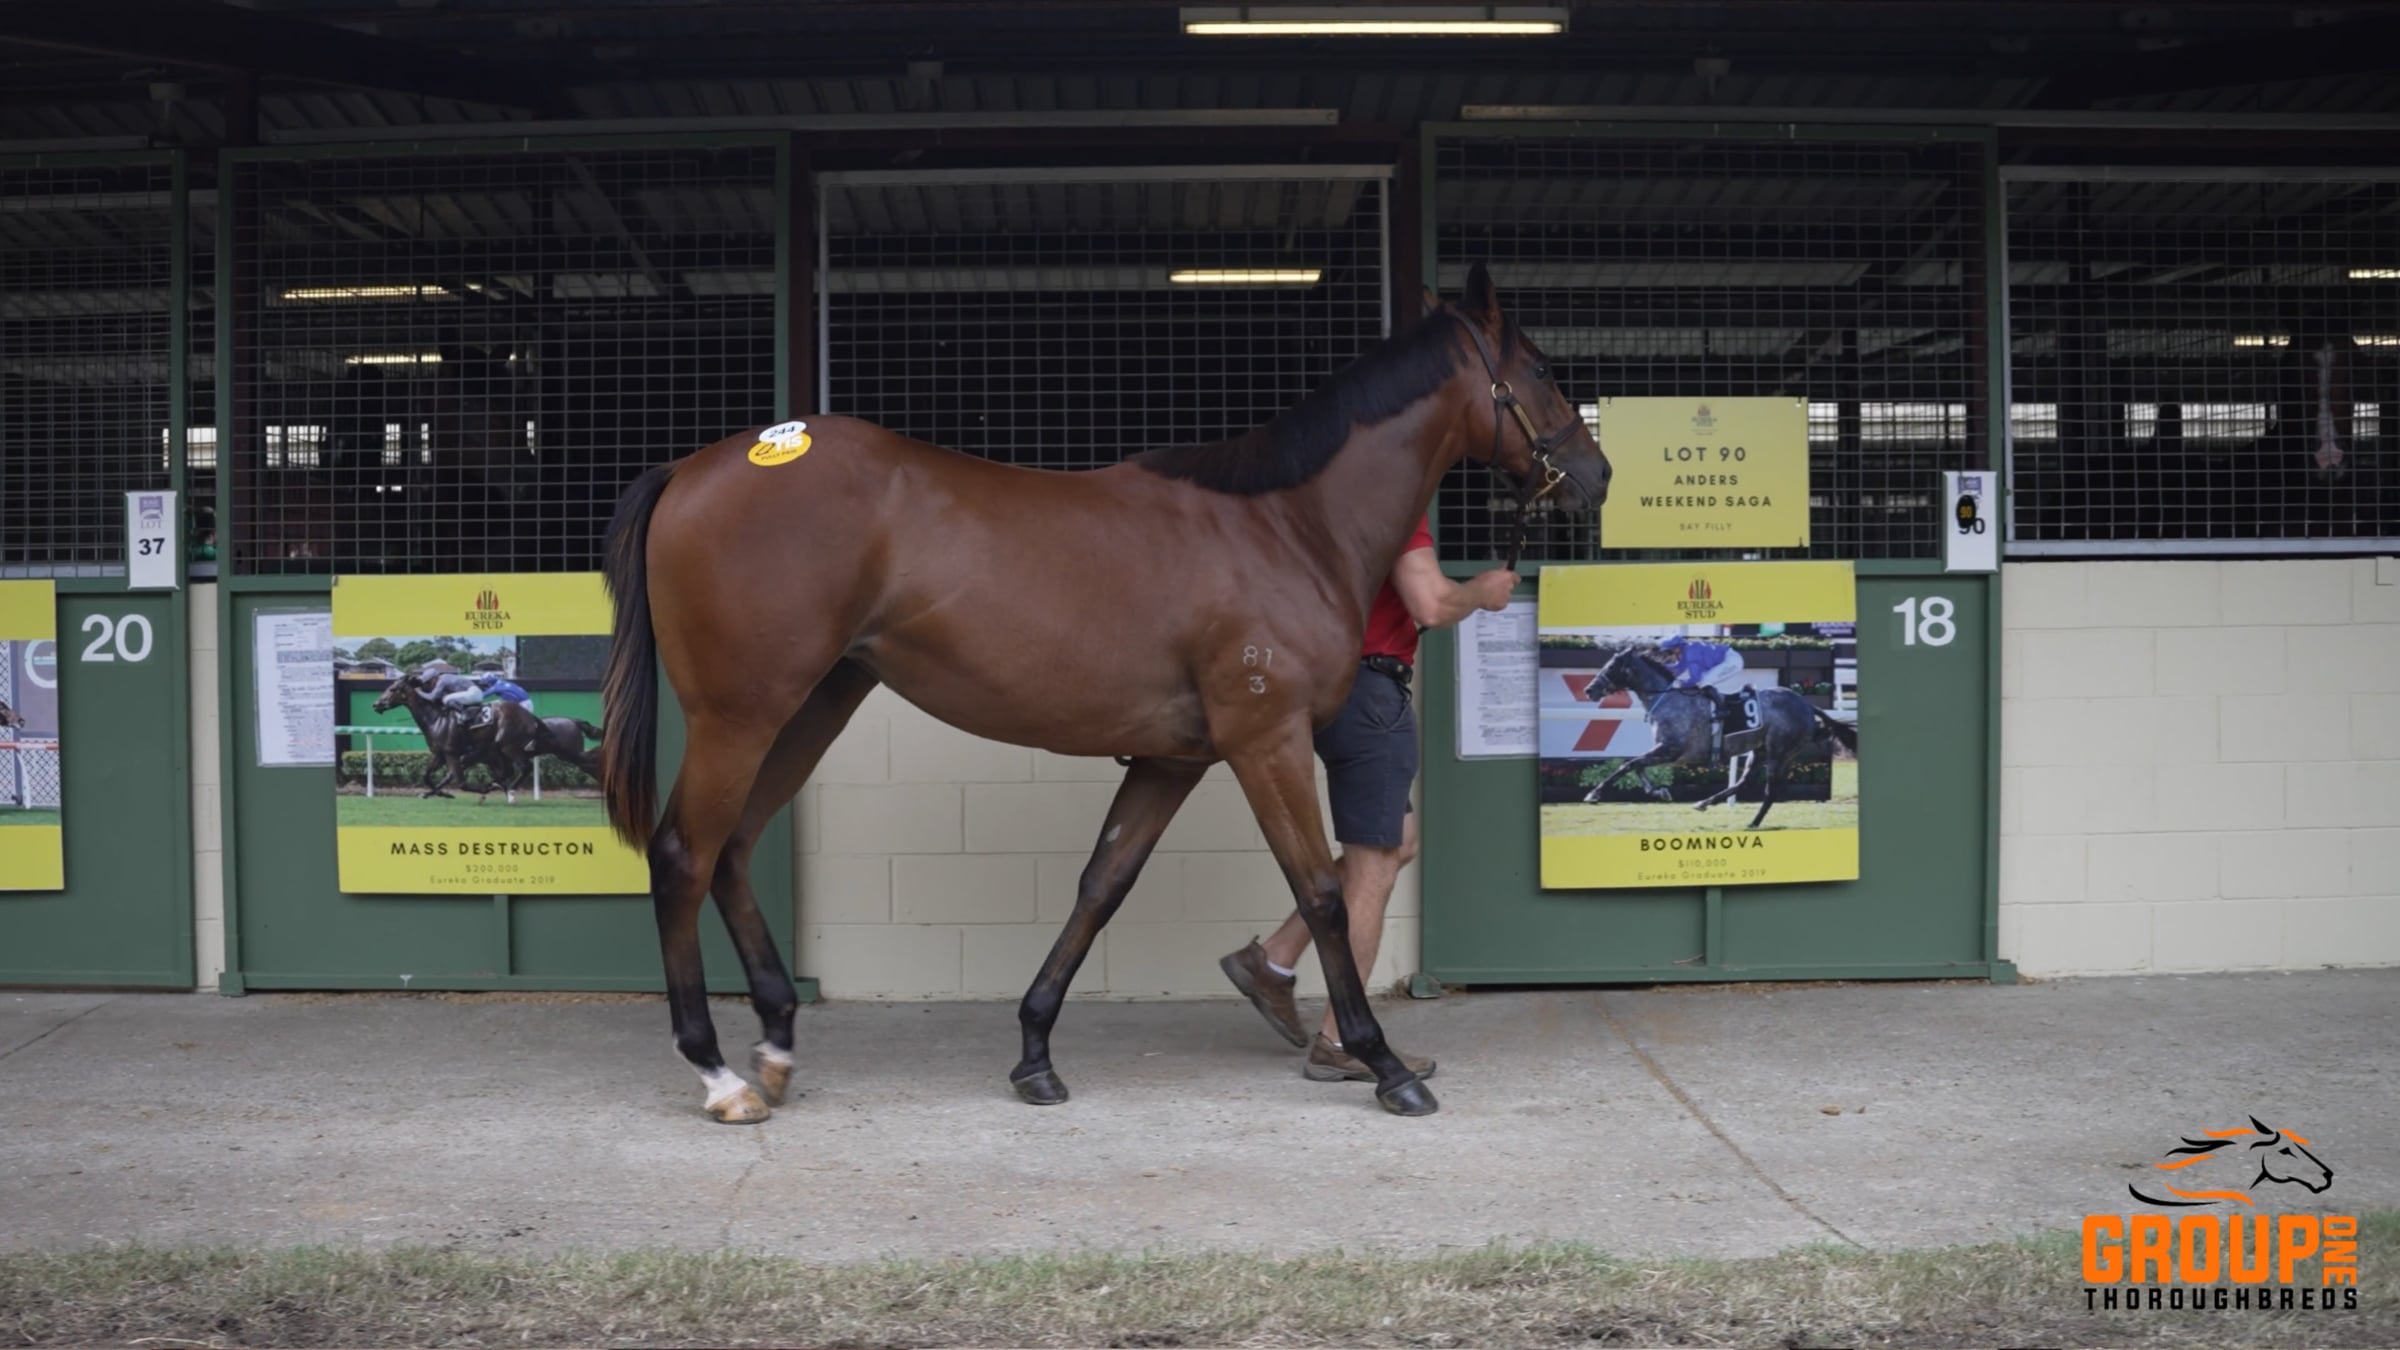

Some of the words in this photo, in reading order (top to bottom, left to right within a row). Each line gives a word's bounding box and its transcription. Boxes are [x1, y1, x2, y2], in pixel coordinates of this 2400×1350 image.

[1664, 447, 1707, 462] LOT
[1719, 447, 1746, 462] 90
[1674, 475, 1739, 485] ANDERS
[1640, 496, 1717, 507] WEEKEND
[1725, 496, 1772, 507] SAGA
[138, 538, 165, 556] 37
[1676, 601, 1724, 610] EUREKA
[464, 611, 511, 621] EUREKA
[1685, 610, 1716, 619] STUD
[1892, 596, 1957, 647] 18
[472, 621, 504, 630] STUD
[80, 614, 153, 662] 20
[1242, 645, 1273, 668] 81
[1249, 675, 1266, 694] 3
[480, 706, 492, 723] 3
[1743, 699, 1760, 728] 9
[391, 843, 448, 855] MASS
[459, 842, 594, 855] DESTRUCTON
[1640, 836, 1764, 851] BOOMNOVA
